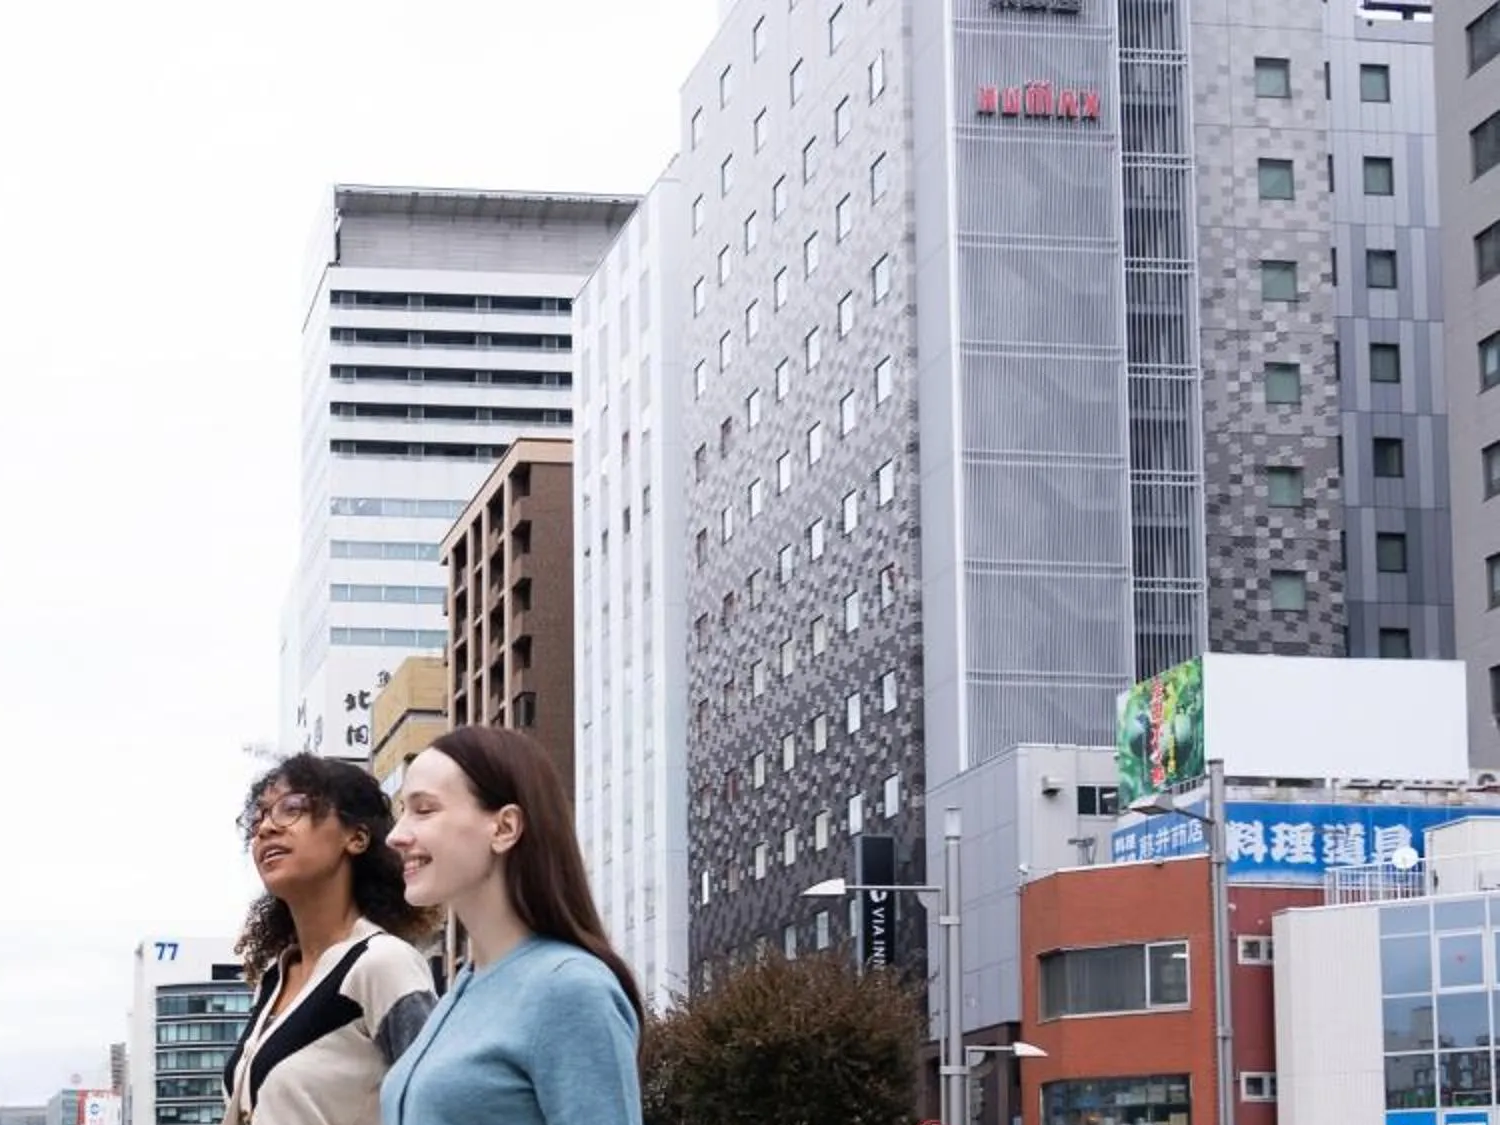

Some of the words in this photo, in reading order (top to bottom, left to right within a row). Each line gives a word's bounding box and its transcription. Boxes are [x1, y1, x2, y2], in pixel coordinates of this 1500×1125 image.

[1225, 819, 1413, 866] 料理道具
[872, 906, 885, 937] VIA
[154, 942, 178, 961] 77
